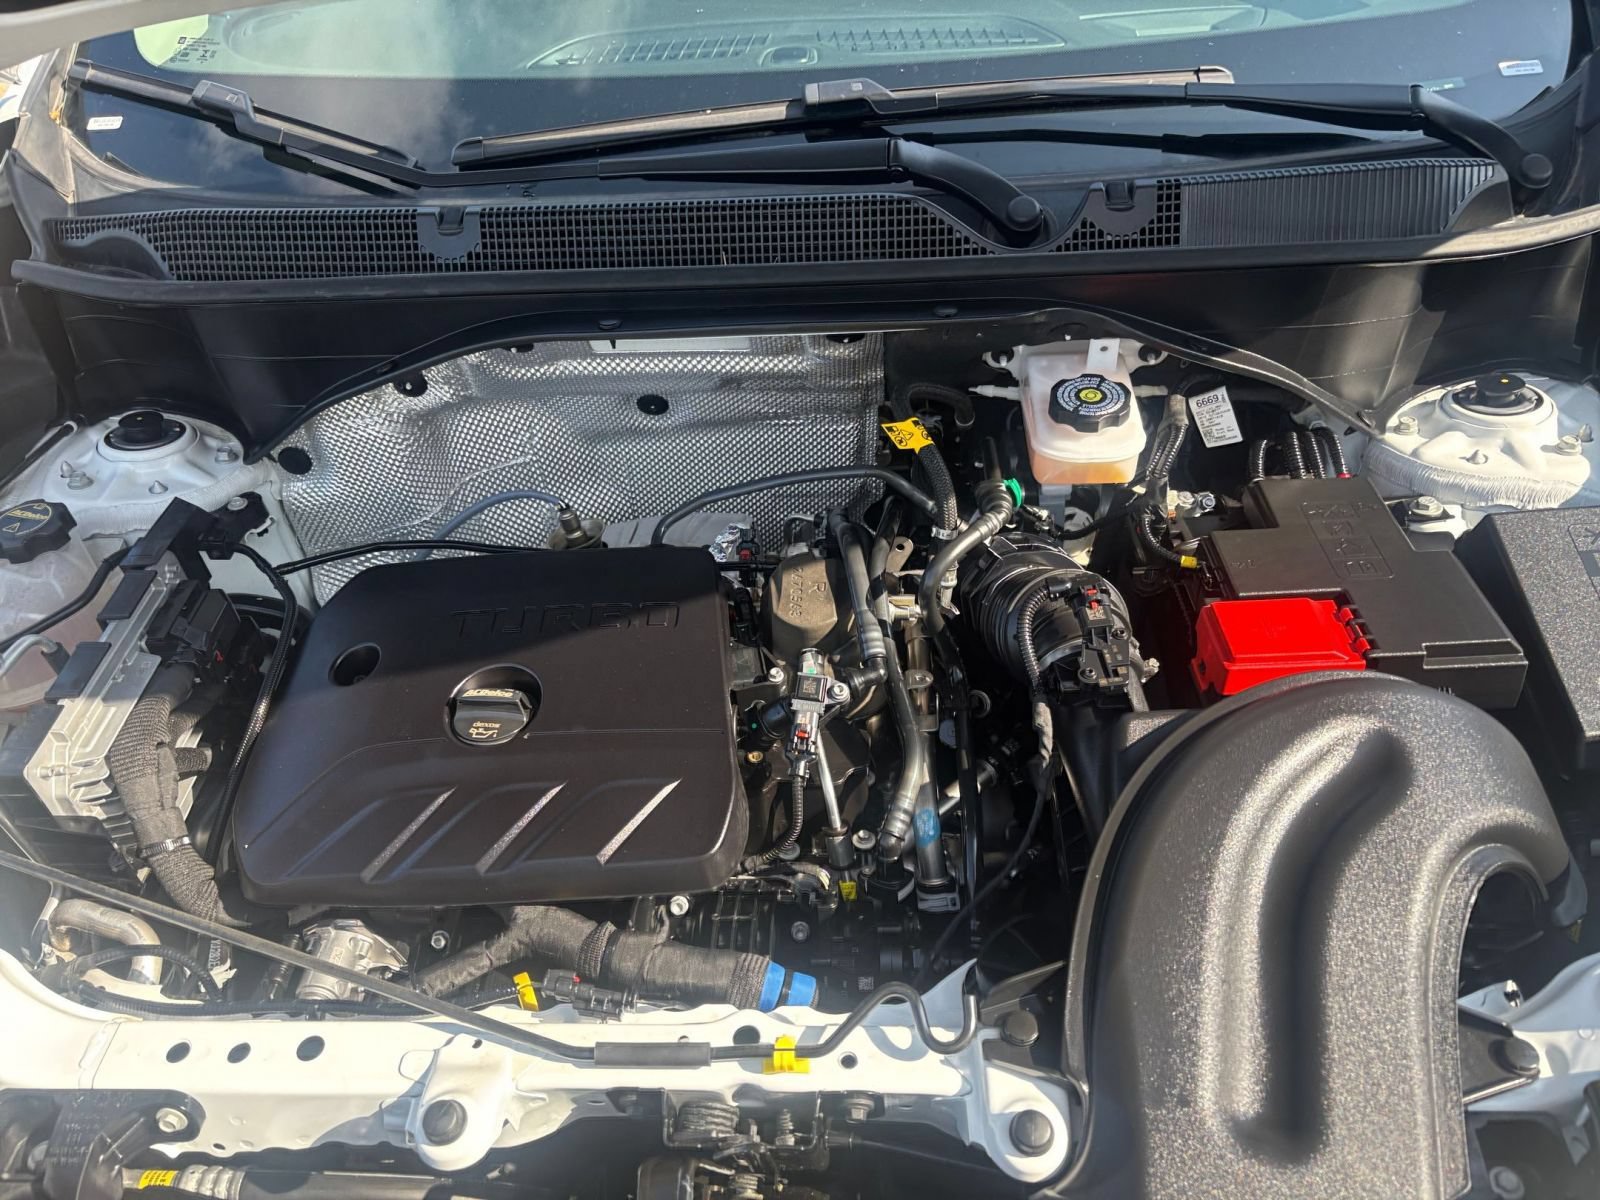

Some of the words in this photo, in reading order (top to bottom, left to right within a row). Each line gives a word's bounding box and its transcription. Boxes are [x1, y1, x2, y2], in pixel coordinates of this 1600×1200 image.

[1196, 394, 1219, 407] 6669
[451, 602, 680, 638] TURBO
[462, 689, 514, 698] ACDelco
